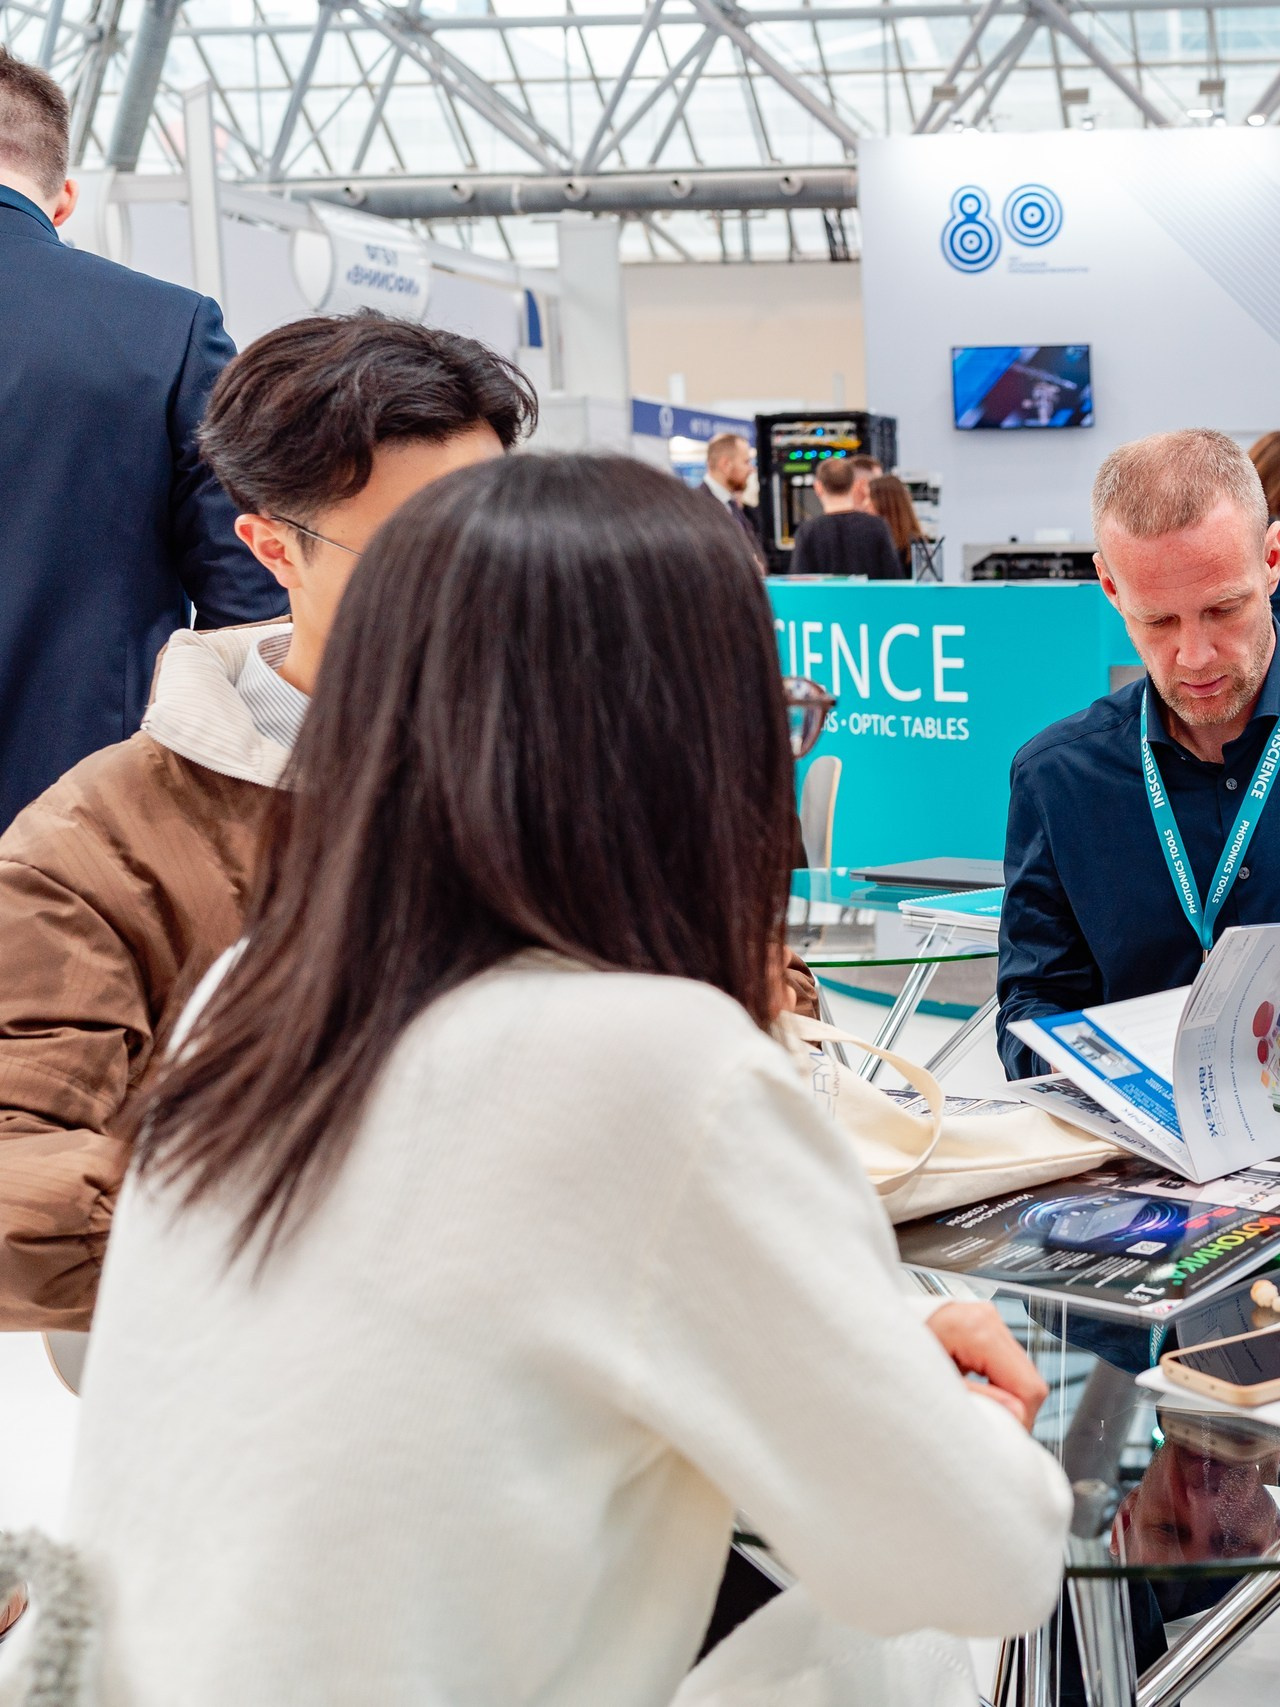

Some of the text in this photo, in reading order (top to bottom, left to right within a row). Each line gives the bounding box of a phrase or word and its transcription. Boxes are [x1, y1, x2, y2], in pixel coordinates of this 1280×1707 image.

[848, 712, 897, 737] OPTIC
[900, 715, 970, 741] TABLES
[1163, 829, 1197, 915] PHOTONICS TOOLS
[1212, 820, 1250, 904] PHOTONICS TOOLS
[1229, 1036, 1237, 1069] Crystals
[1233, 1094, 1255, 1142] Professional
